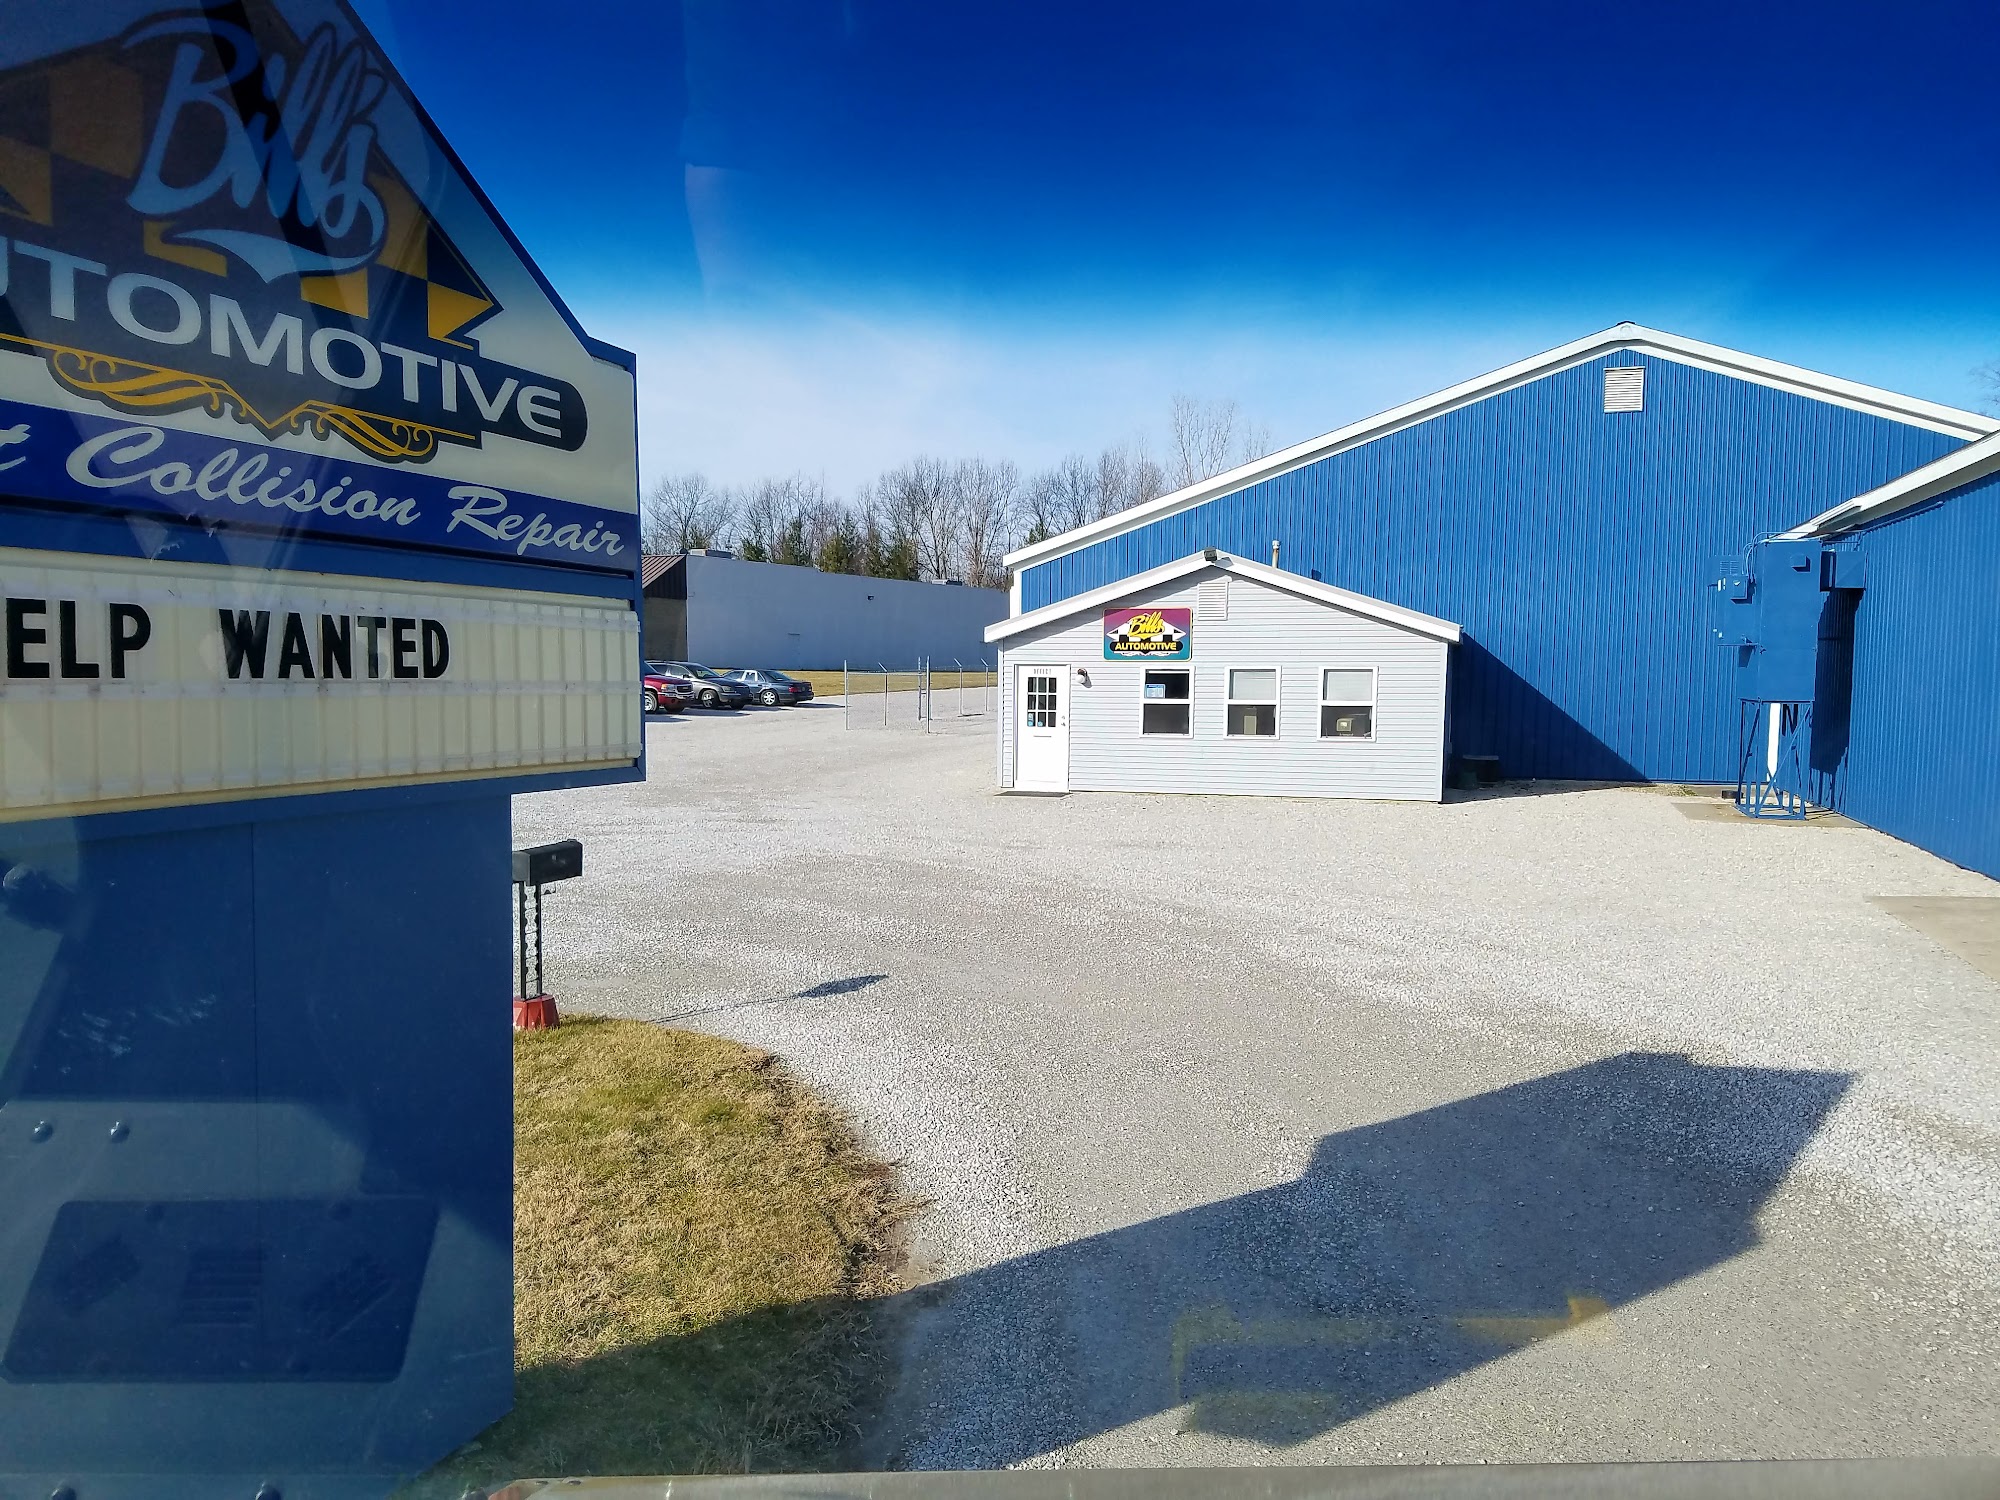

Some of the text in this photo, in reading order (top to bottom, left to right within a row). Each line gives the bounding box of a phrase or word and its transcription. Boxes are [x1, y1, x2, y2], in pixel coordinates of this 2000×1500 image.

[65, 425, 422, 525] Collision
[446, 485, 625, 557] Repair
[219, 608, 451, 679] WANTED
[1114, 642, 1177, 651] AUTOMOTIVE
